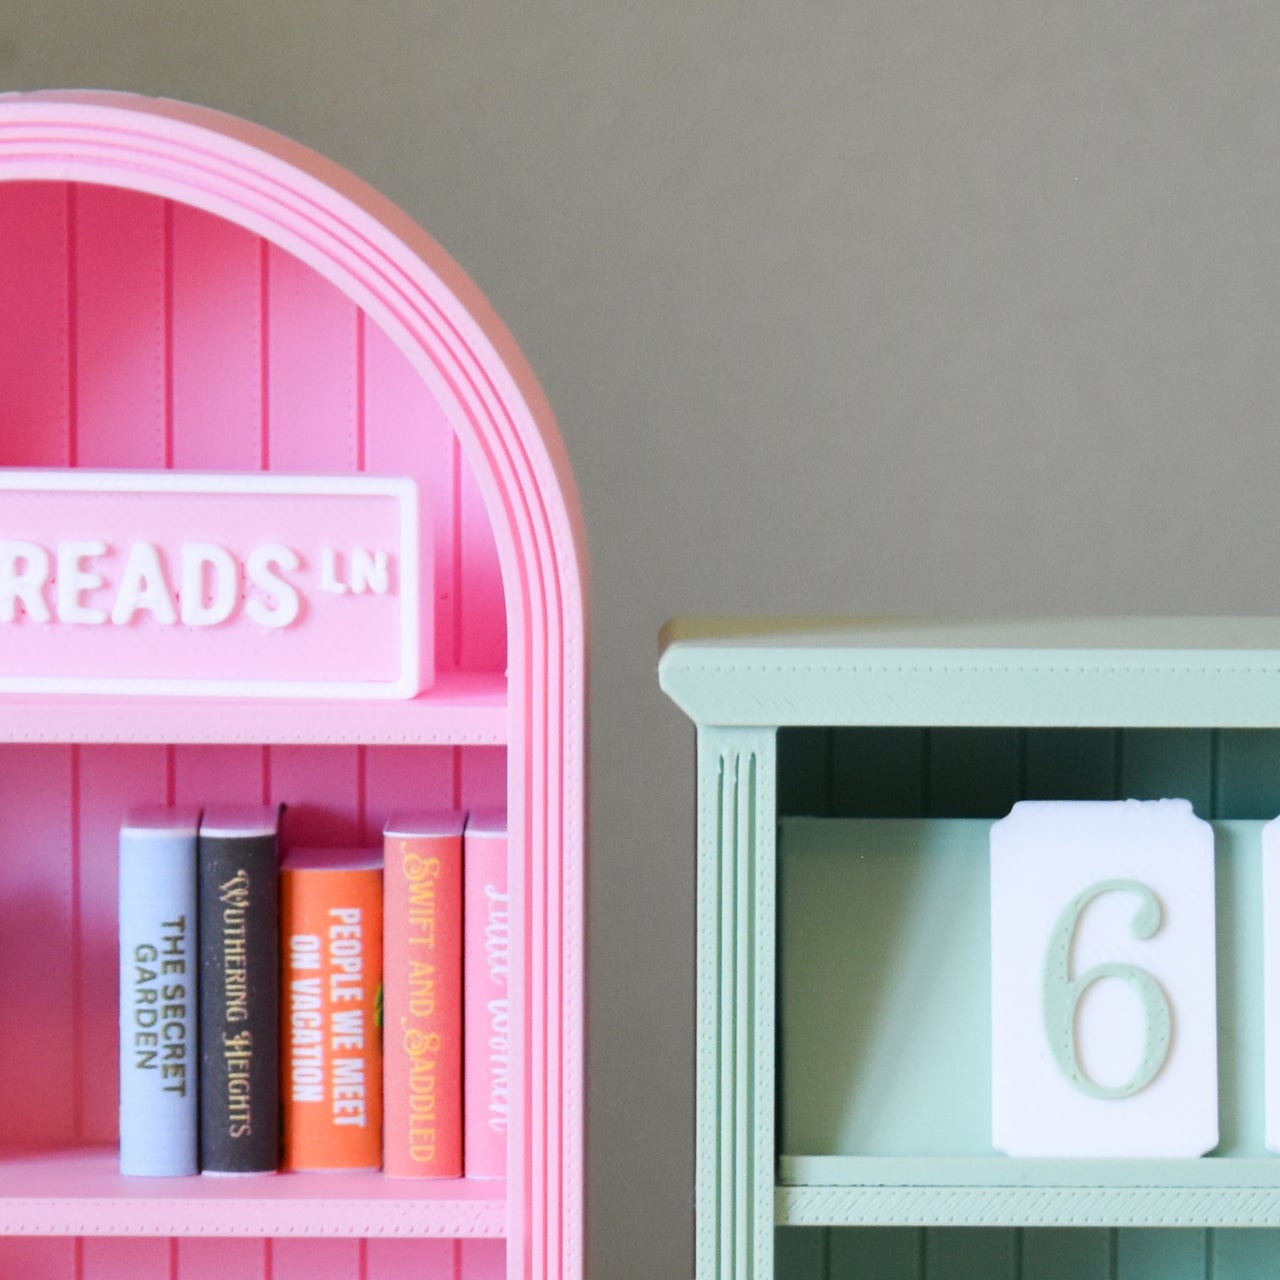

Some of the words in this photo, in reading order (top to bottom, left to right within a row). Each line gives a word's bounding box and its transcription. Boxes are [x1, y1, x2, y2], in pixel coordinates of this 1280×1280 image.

[321, 547, 391, 594] LN
[161, 915, 186, 975] THE
[218, 868, 251, 1022] WUTHERING
[400, 841, 441, 949] SWIFT
[289, 934, 321, 970] ON
[329, 907, 363, 1002] PEOPLE
[409, 961, 436, 1018] AND
[134, 944, 157, 1070] GARDEN
[161, 986, 187, 1097] SECRET
[291, 976, 324, 1103] VACATION
[331, 1009, 364, 1050] WE
[221, 1030, 252, 1139] HEIGHTS
[333, 1059, 367, 1127] MEET
[401, 1016, 441, 1163] SADDLED
